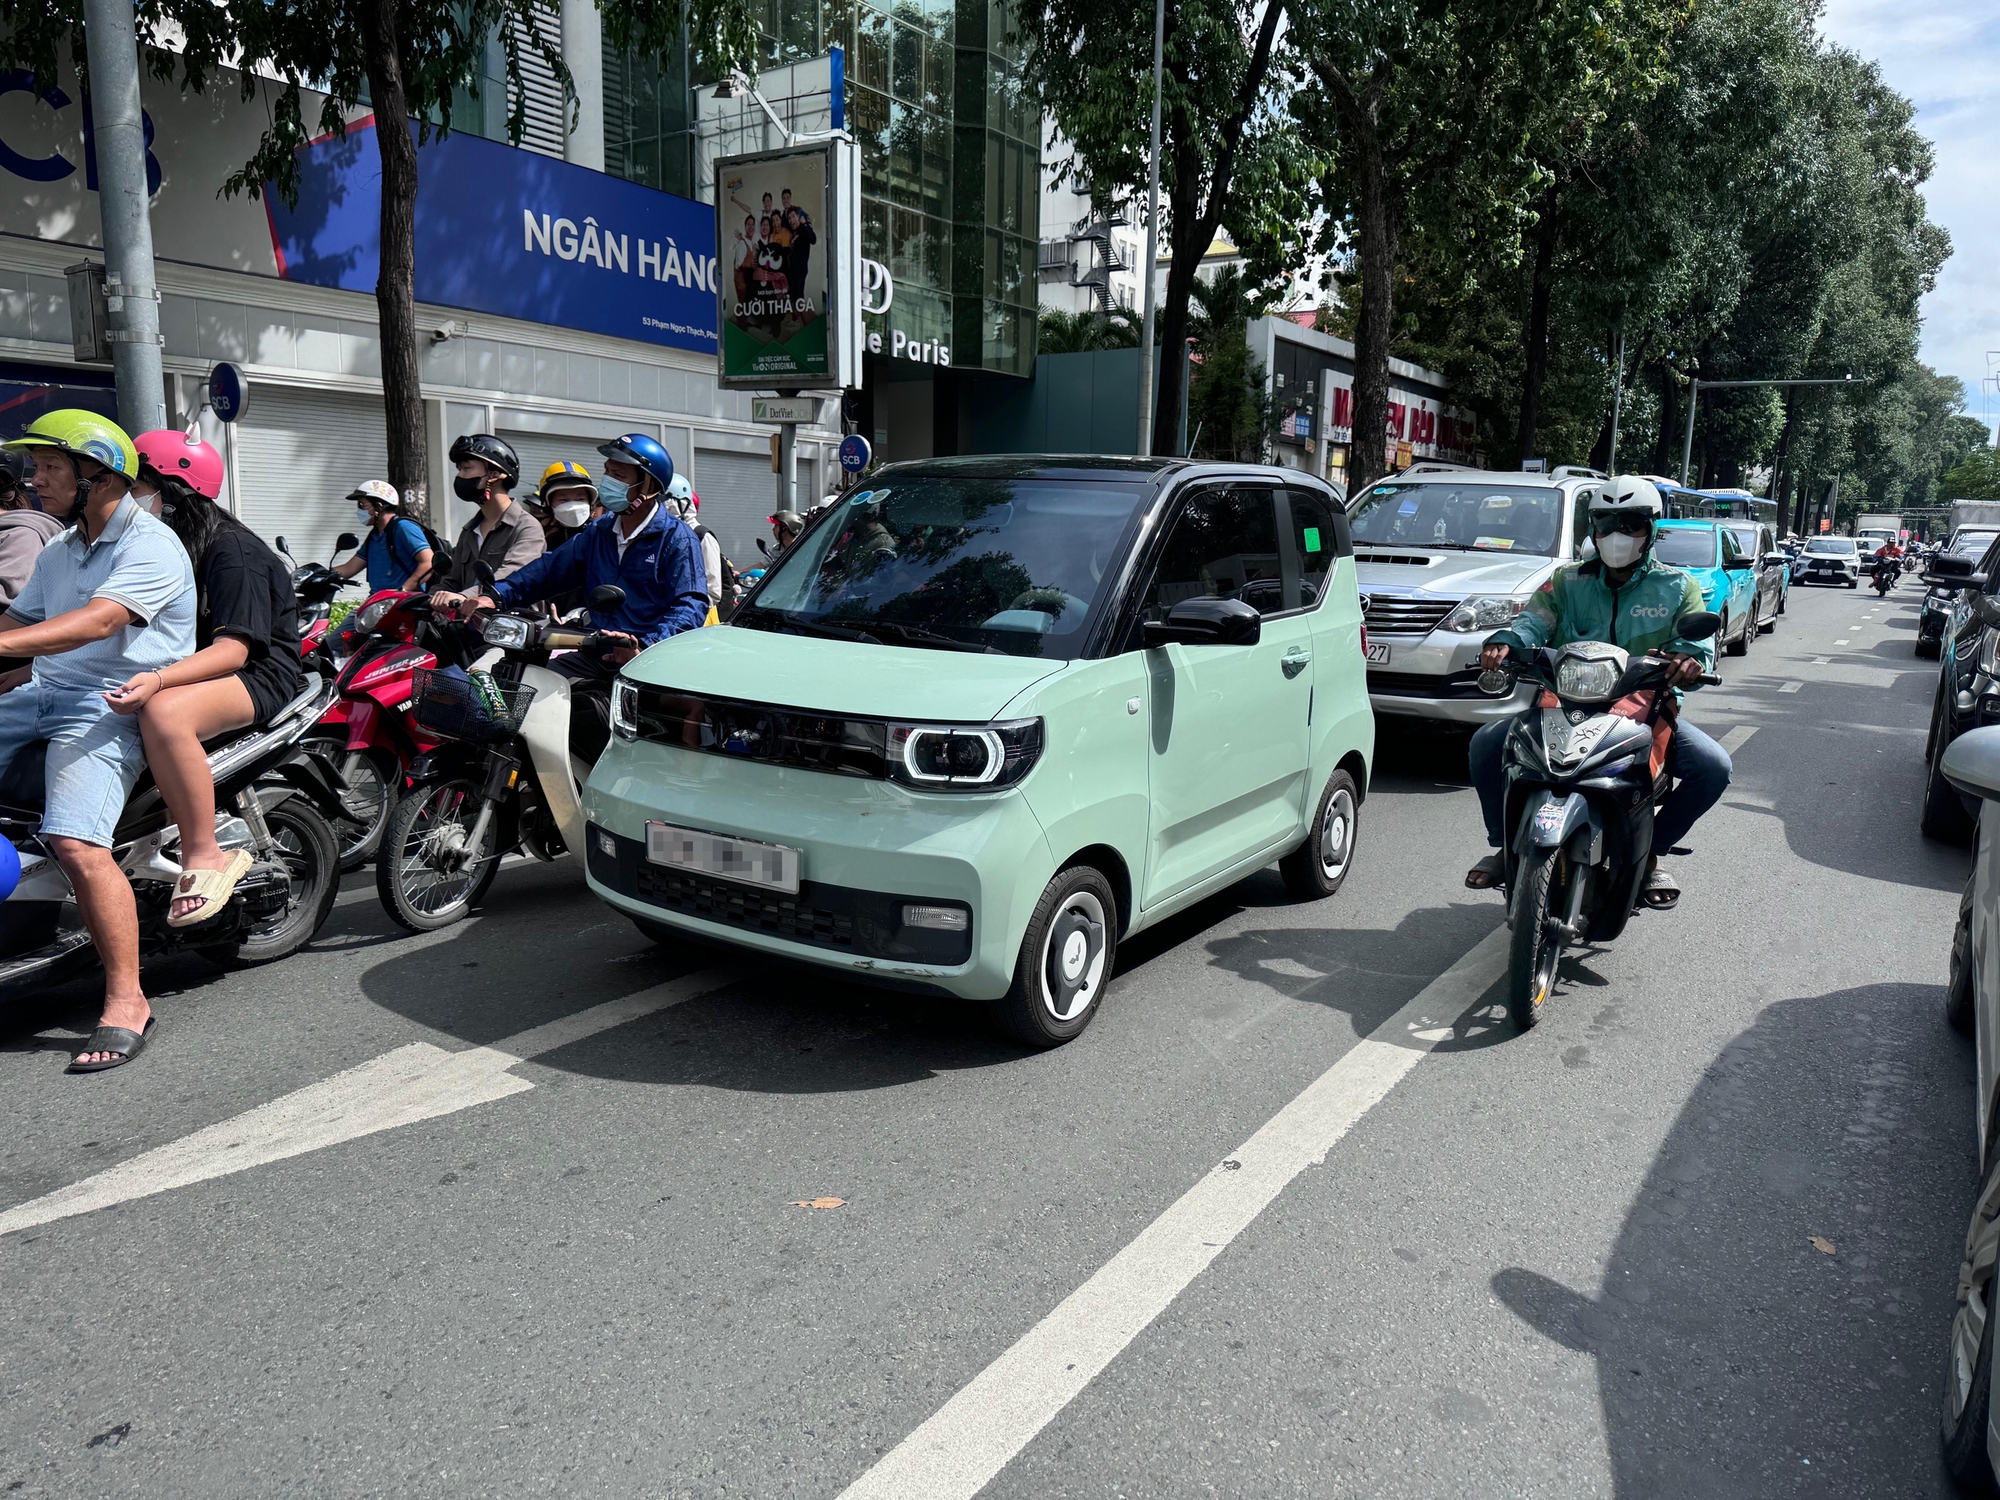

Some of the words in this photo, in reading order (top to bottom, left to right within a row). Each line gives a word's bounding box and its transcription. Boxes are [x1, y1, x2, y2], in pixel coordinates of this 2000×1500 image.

[524, 208, 629, 274] NGÂN
[734, 298, 765, 317] CƯỜI
[767, 294, 793, 315] THẢ
[795, 297, 815, 313] GA
[642, 317, 651, 327] 53
[652, 319, 670, 331] Phạm
[670, 322, 686, 334] Ngọc
[892, 329, 950, 366] Paris
[211, 395, 231, 411] SCB
[842, 455, 860, 465] SCB
[404, 489, 426, 504] 85
[1630, 604, 1669, 618] Grab
[365, 658, 409, 680] JUPITER
[261, 887, 288, 898] HONDA
